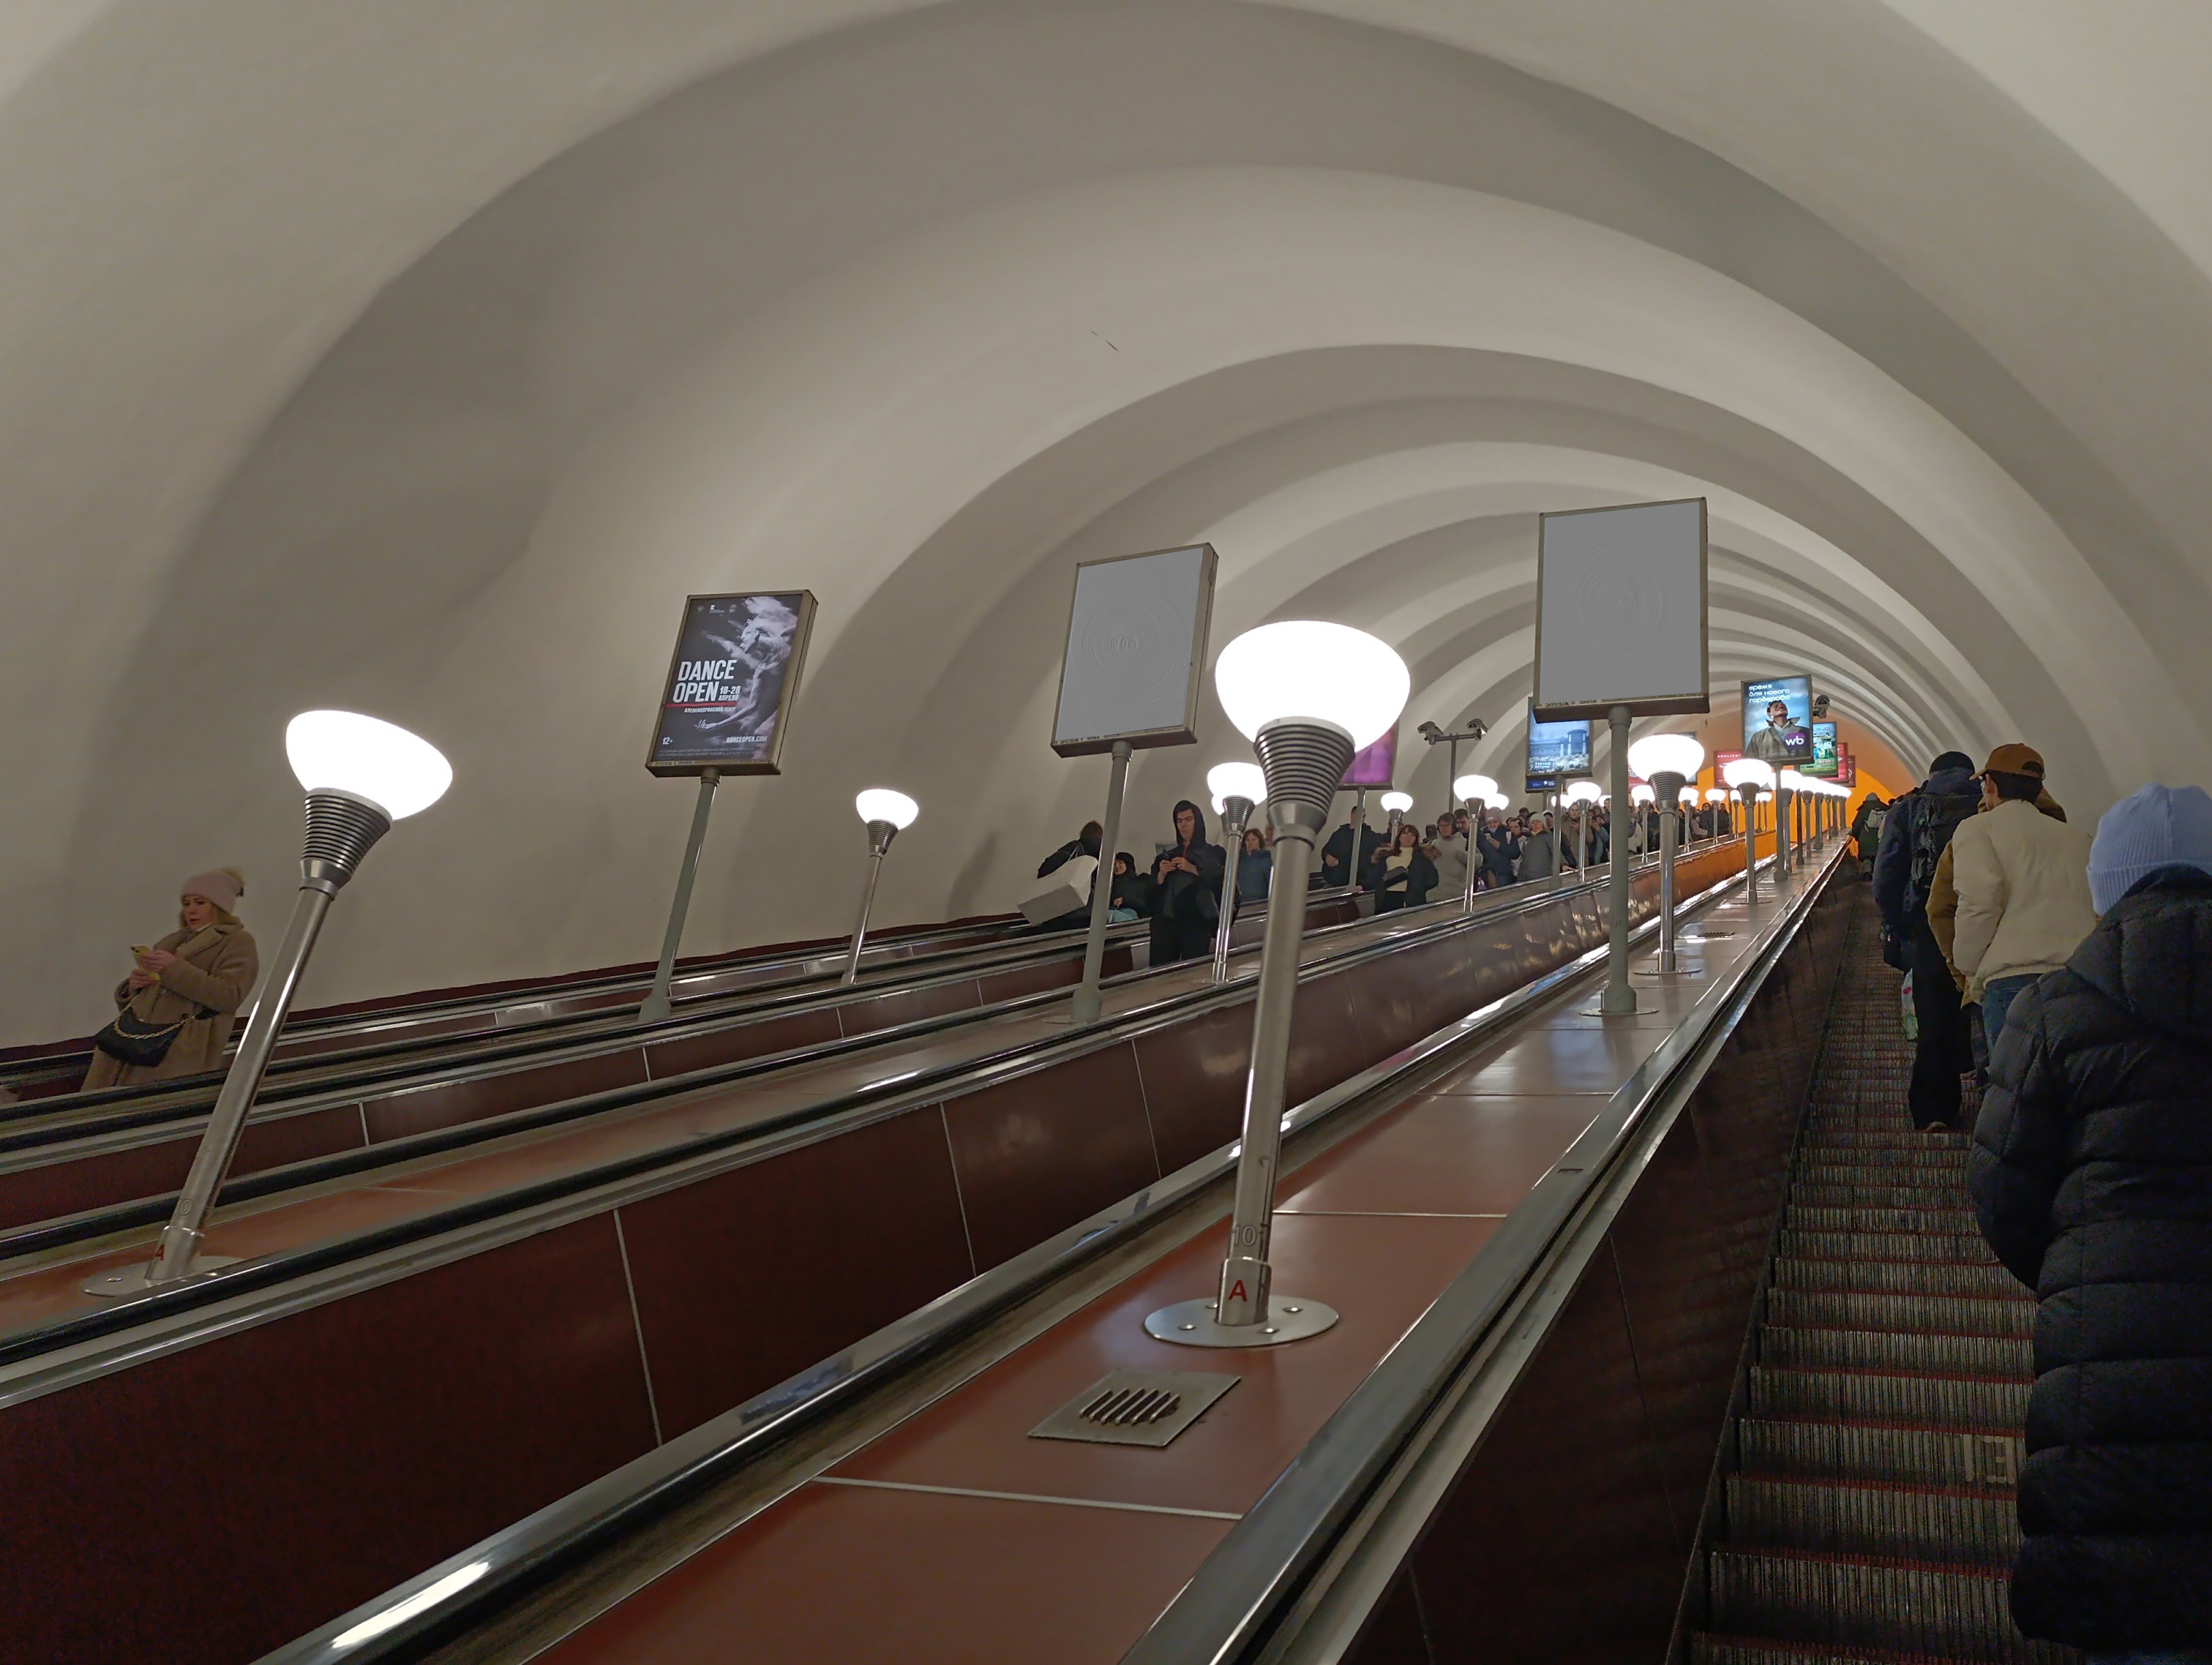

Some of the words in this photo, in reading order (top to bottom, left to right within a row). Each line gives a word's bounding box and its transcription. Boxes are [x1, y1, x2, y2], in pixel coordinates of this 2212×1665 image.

[678, 660, 737, 681] DANCE
[673, 682, 719, 703] OPEN
[720, 686, 741, 694] 18-28
[1749, 694, 1790, 703] гардероба
[662, 737, 673, 745] 12+
[1785, 735, 1804, 746] wb
[1228, 1279, 1247, 1302] A
